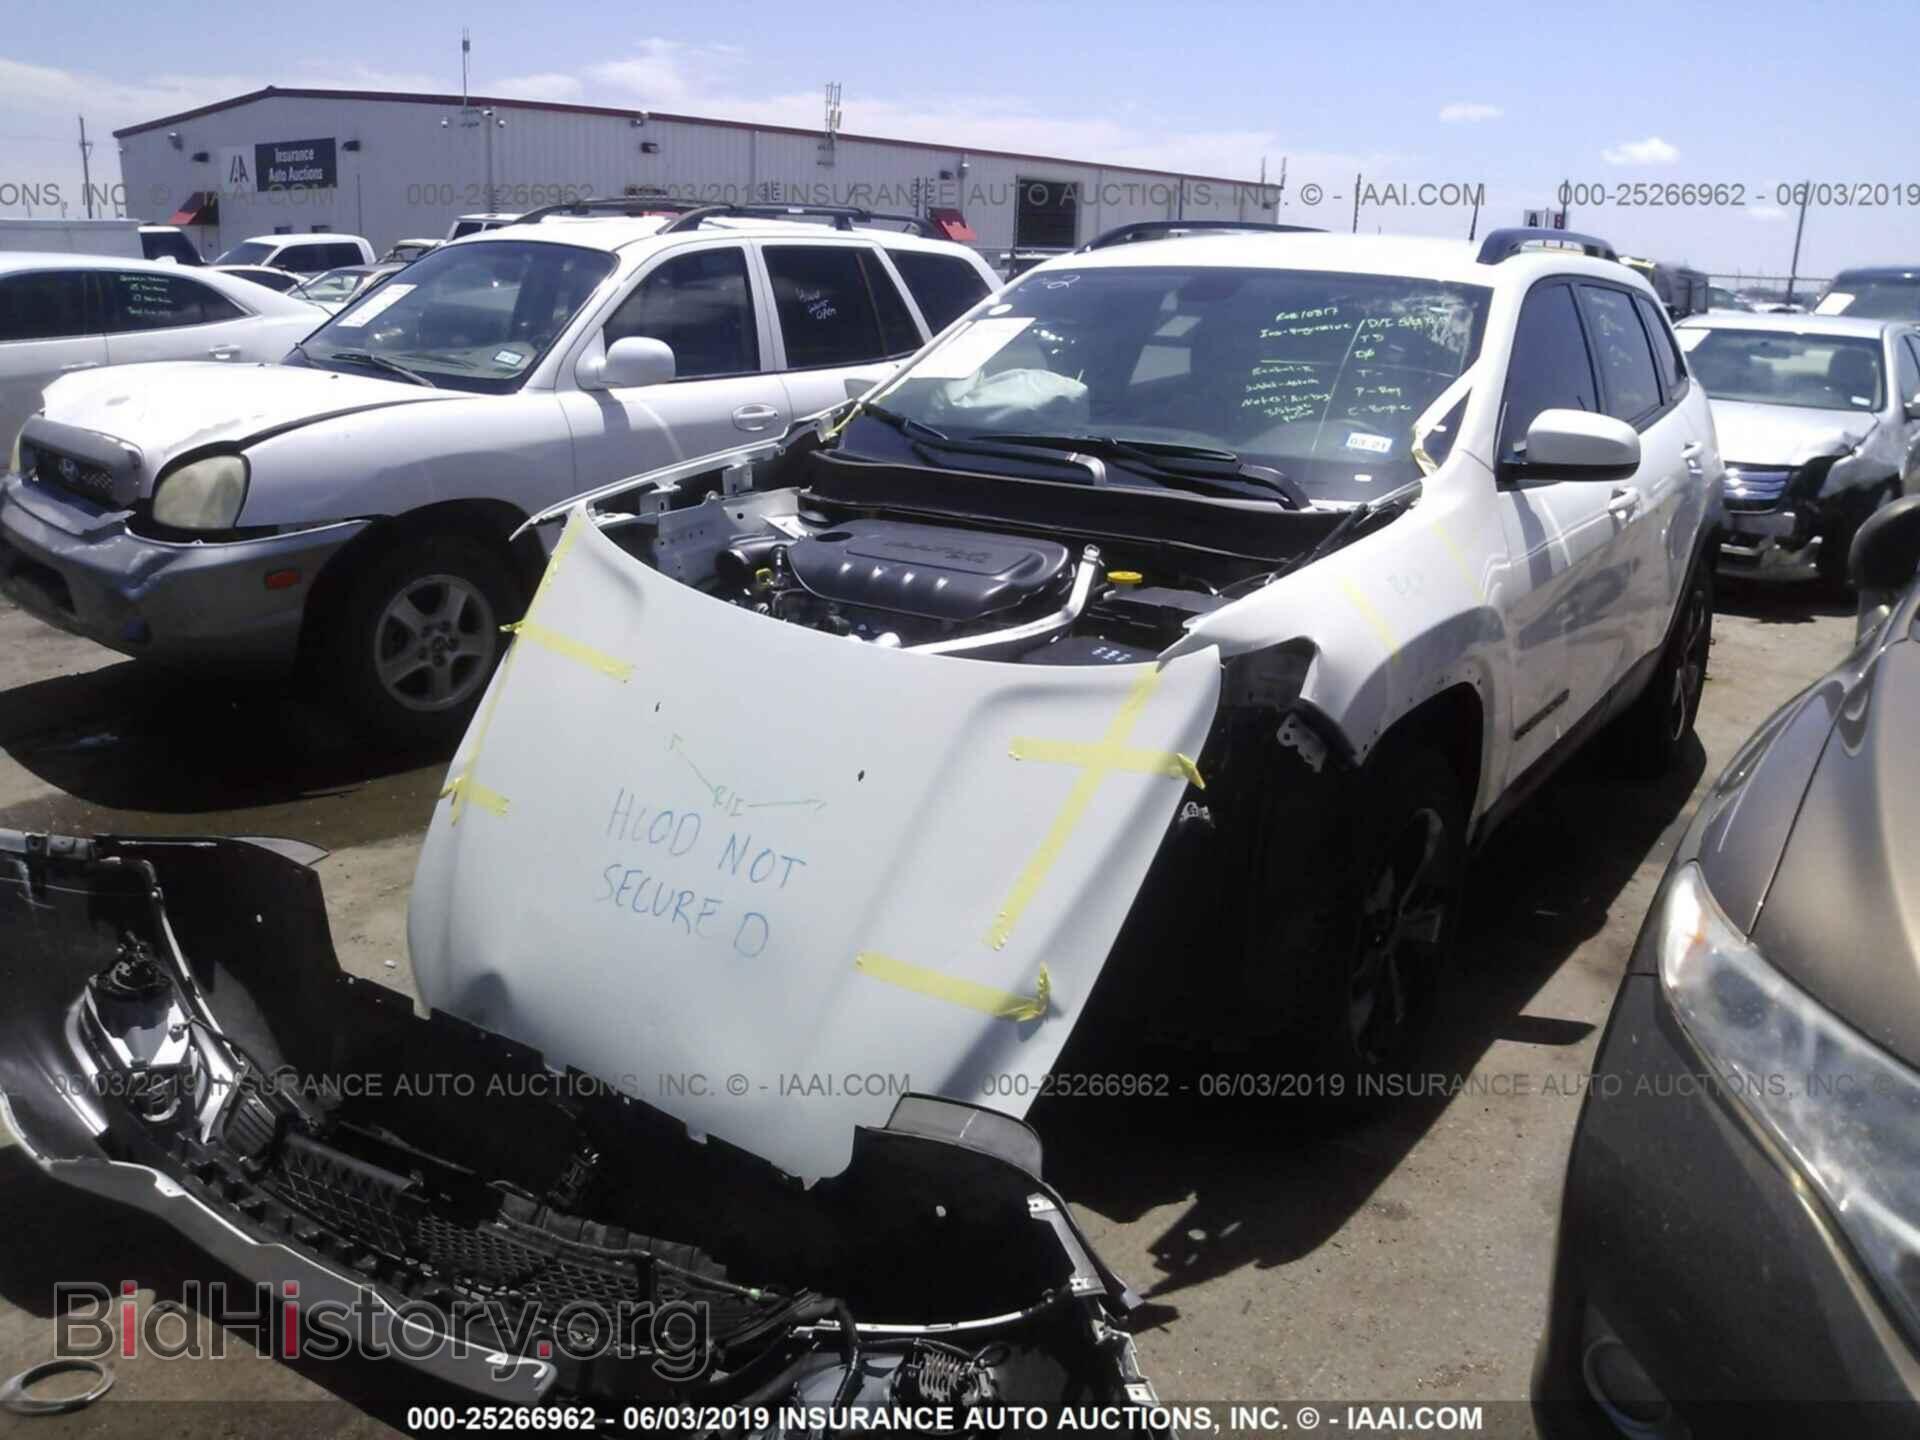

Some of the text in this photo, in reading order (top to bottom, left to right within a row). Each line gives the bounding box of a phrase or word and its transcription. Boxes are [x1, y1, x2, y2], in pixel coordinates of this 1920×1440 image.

[274, 148, 315, 163] Insurance
[268, 165, 323, 182] Auto Auctions
[717, 832, 808, 890] NOT
